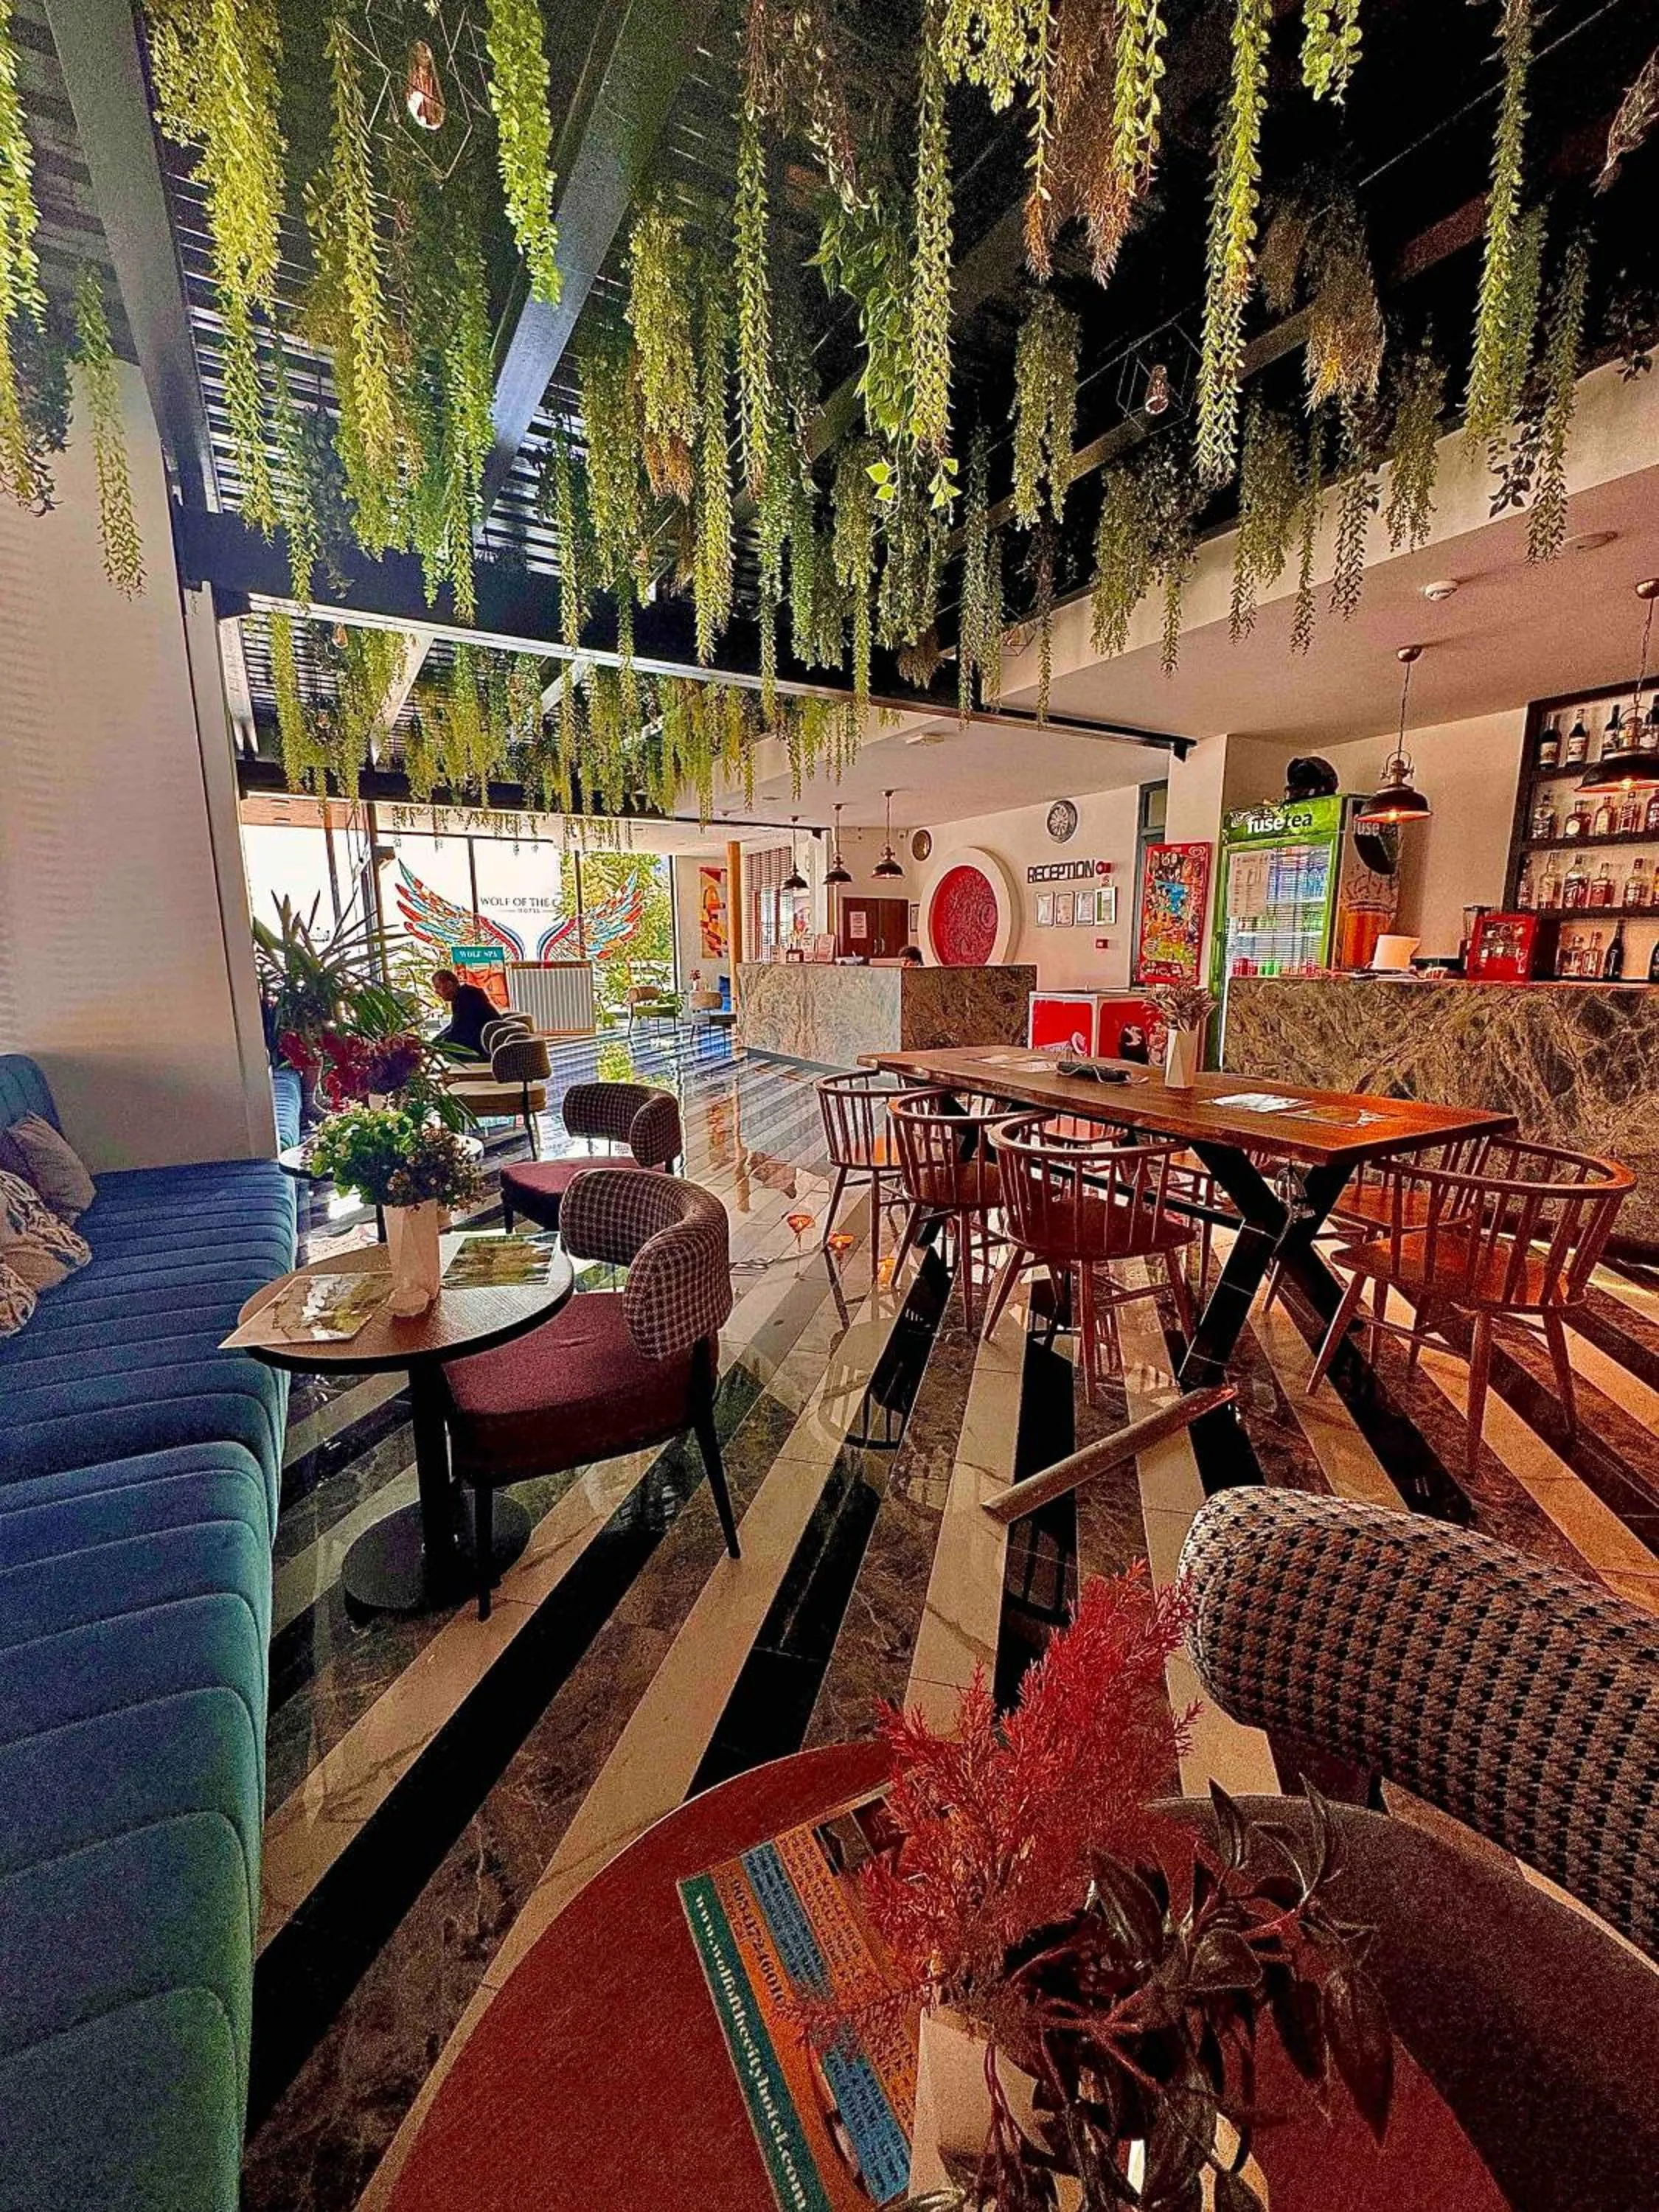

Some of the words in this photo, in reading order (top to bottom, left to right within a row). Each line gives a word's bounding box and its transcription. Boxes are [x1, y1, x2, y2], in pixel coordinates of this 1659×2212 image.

[1027, 859, 1094, 883] RECEPTION
[480, 897, 510, 906] WOLF
[512, 897, 526, 907] OF
[529, 897, 549, 907] THE
[695, 1893, 809, 2211] www.wolfofthecityhotel.com
